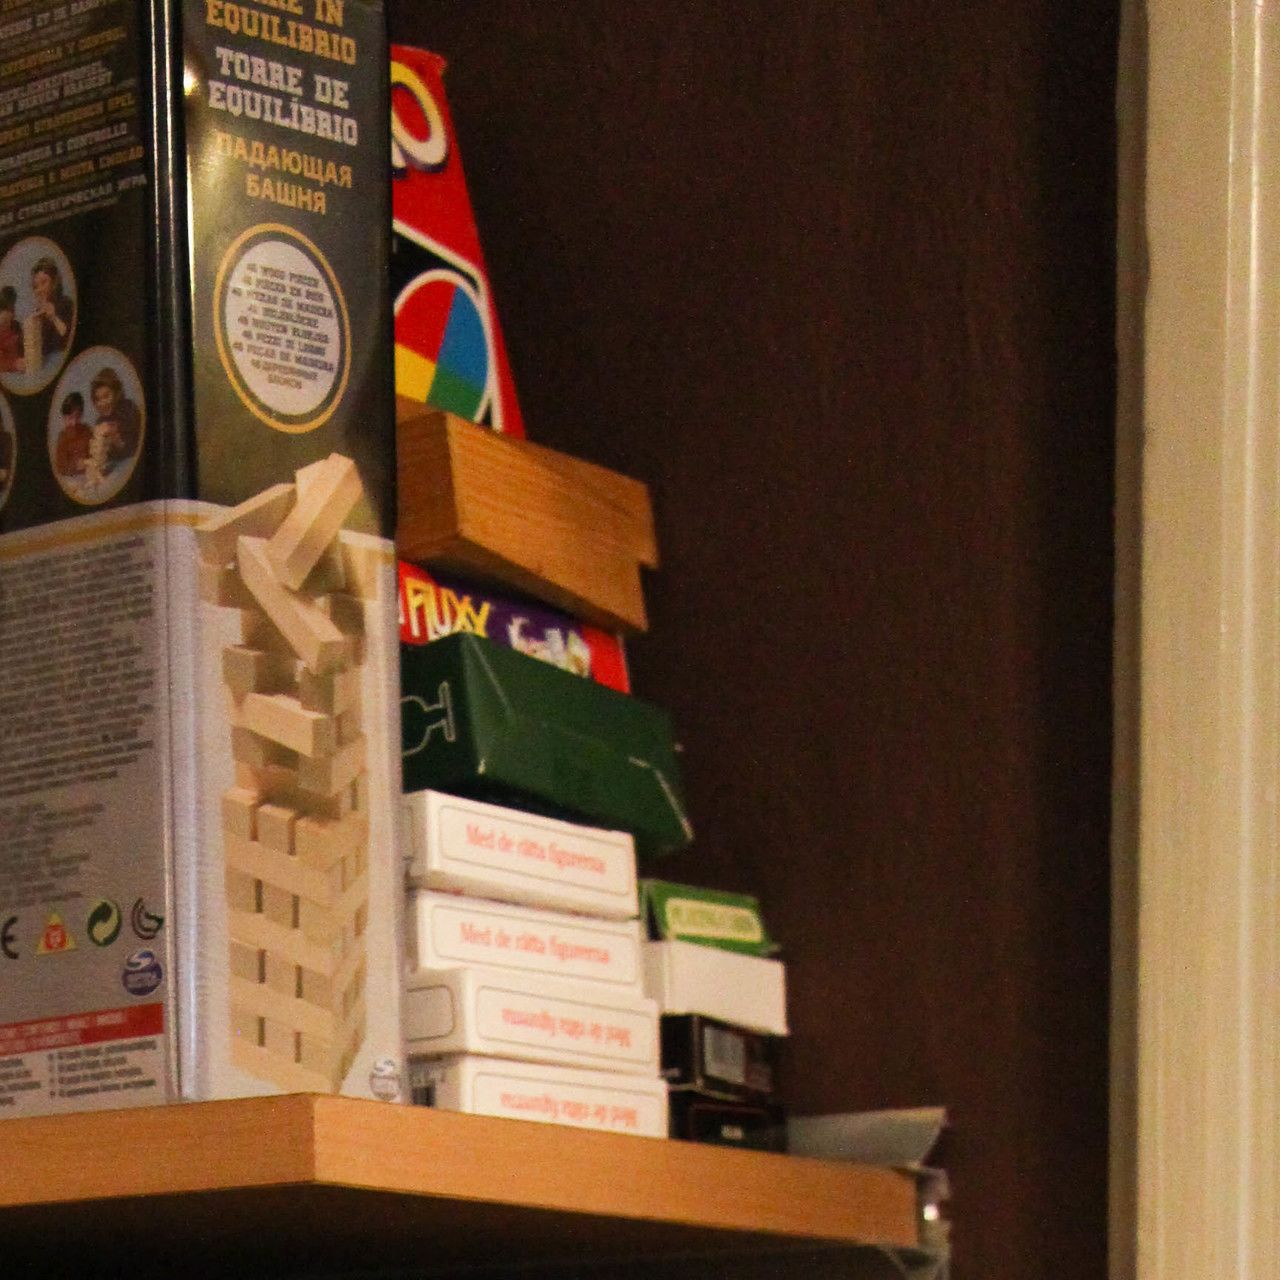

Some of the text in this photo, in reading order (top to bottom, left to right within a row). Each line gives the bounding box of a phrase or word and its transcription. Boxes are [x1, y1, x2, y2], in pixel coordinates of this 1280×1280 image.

[206, 2, 357, 65] EQUILIBRIO
[215, 46, 350, 110] TORRE DE
[216, 129, 353, 188] ПАДАЮЩАЯ
[246, 172, 327, 215] БАШНЯ
